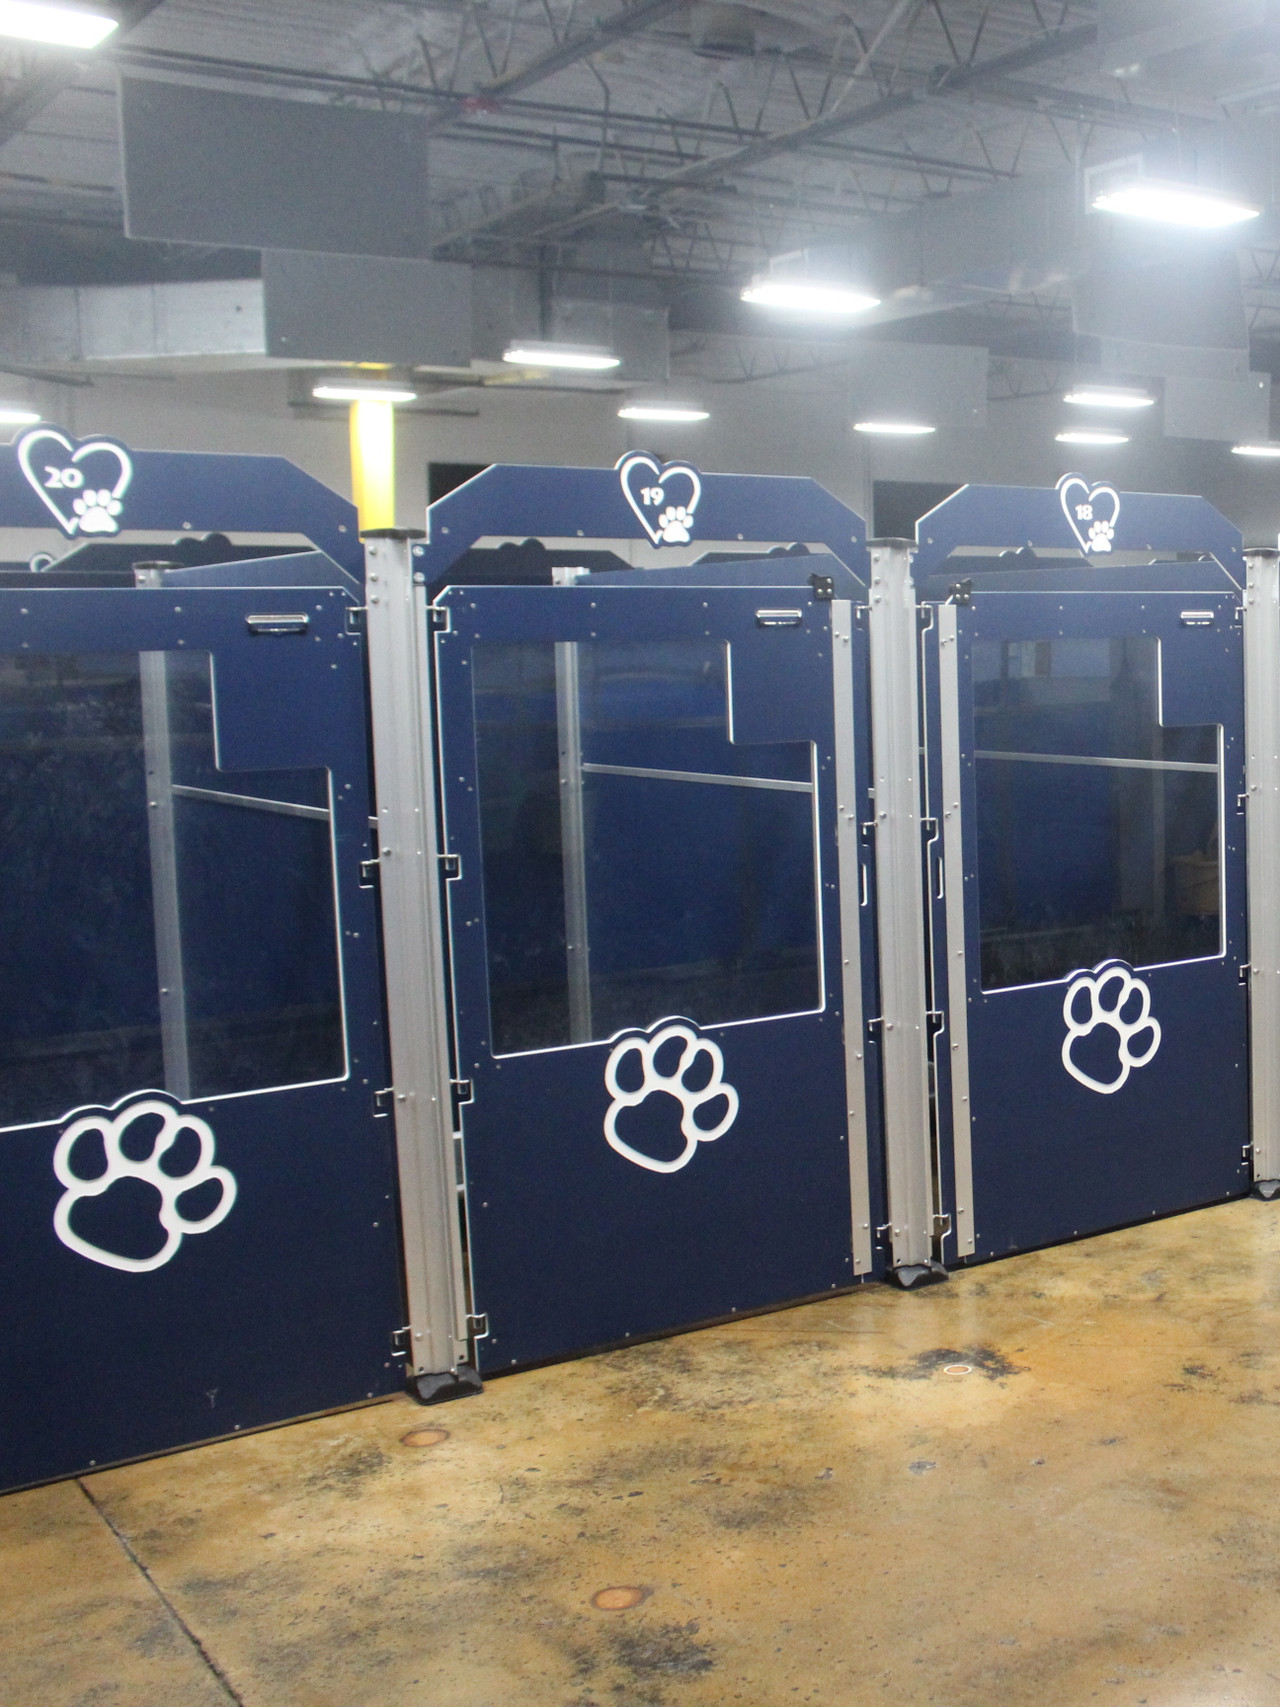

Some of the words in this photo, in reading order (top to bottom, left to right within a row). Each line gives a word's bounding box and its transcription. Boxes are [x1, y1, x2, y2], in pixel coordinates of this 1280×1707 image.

[44, 465, 85, 488] 20
[640, 487, 665, 506] 19
[1075, 504, 1093, 520] 18
